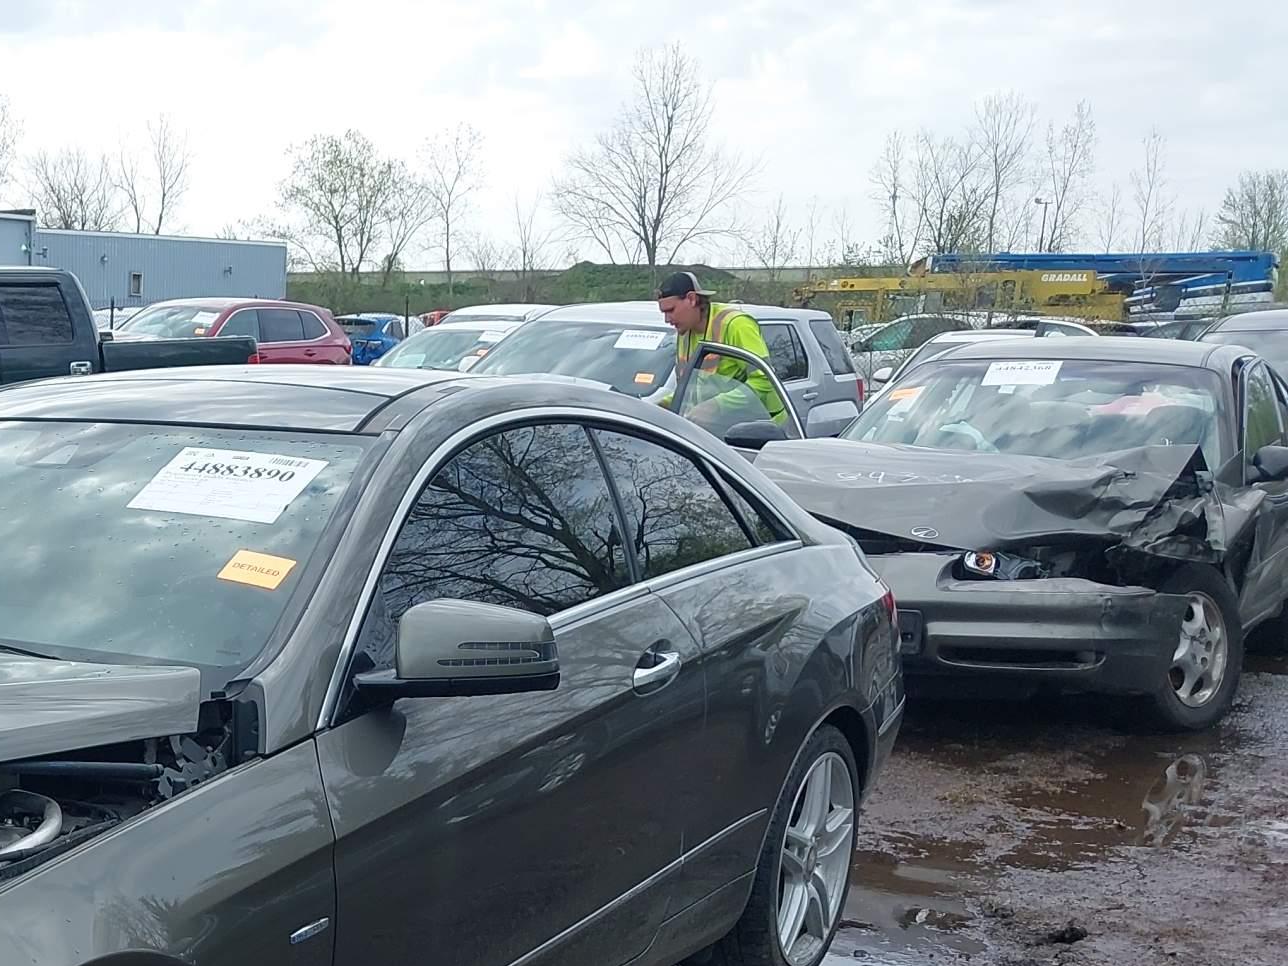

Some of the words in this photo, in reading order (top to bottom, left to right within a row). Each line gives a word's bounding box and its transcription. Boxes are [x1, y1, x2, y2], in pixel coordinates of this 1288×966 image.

[1041, 273, 1088, 282] GRADALL
[179, 461, 295, 482] 44883890
[231, 562, 281, 577] DETAILED
